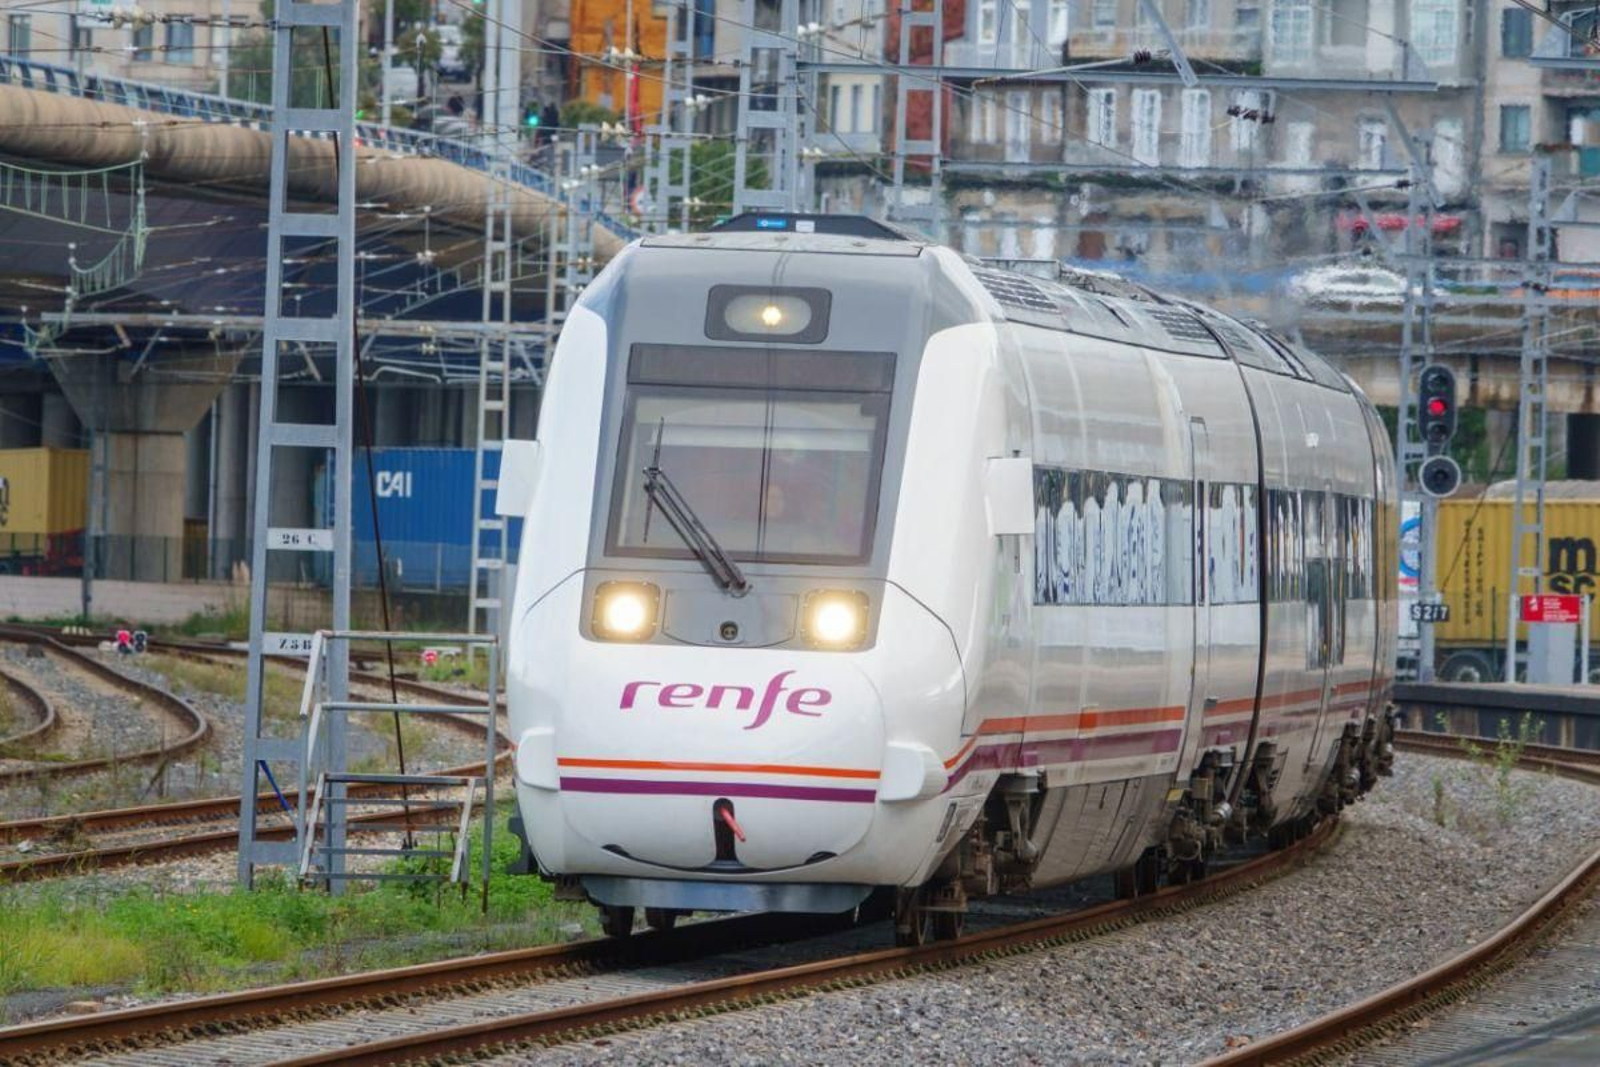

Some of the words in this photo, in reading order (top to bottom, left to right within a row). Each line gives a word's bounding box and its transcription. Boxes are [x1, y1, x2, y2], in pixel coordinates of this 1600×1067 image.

[377, 471, 412, 497] CAI
[281, 533, 300, 545] 26
[619, 670, 832, 730] renfe
